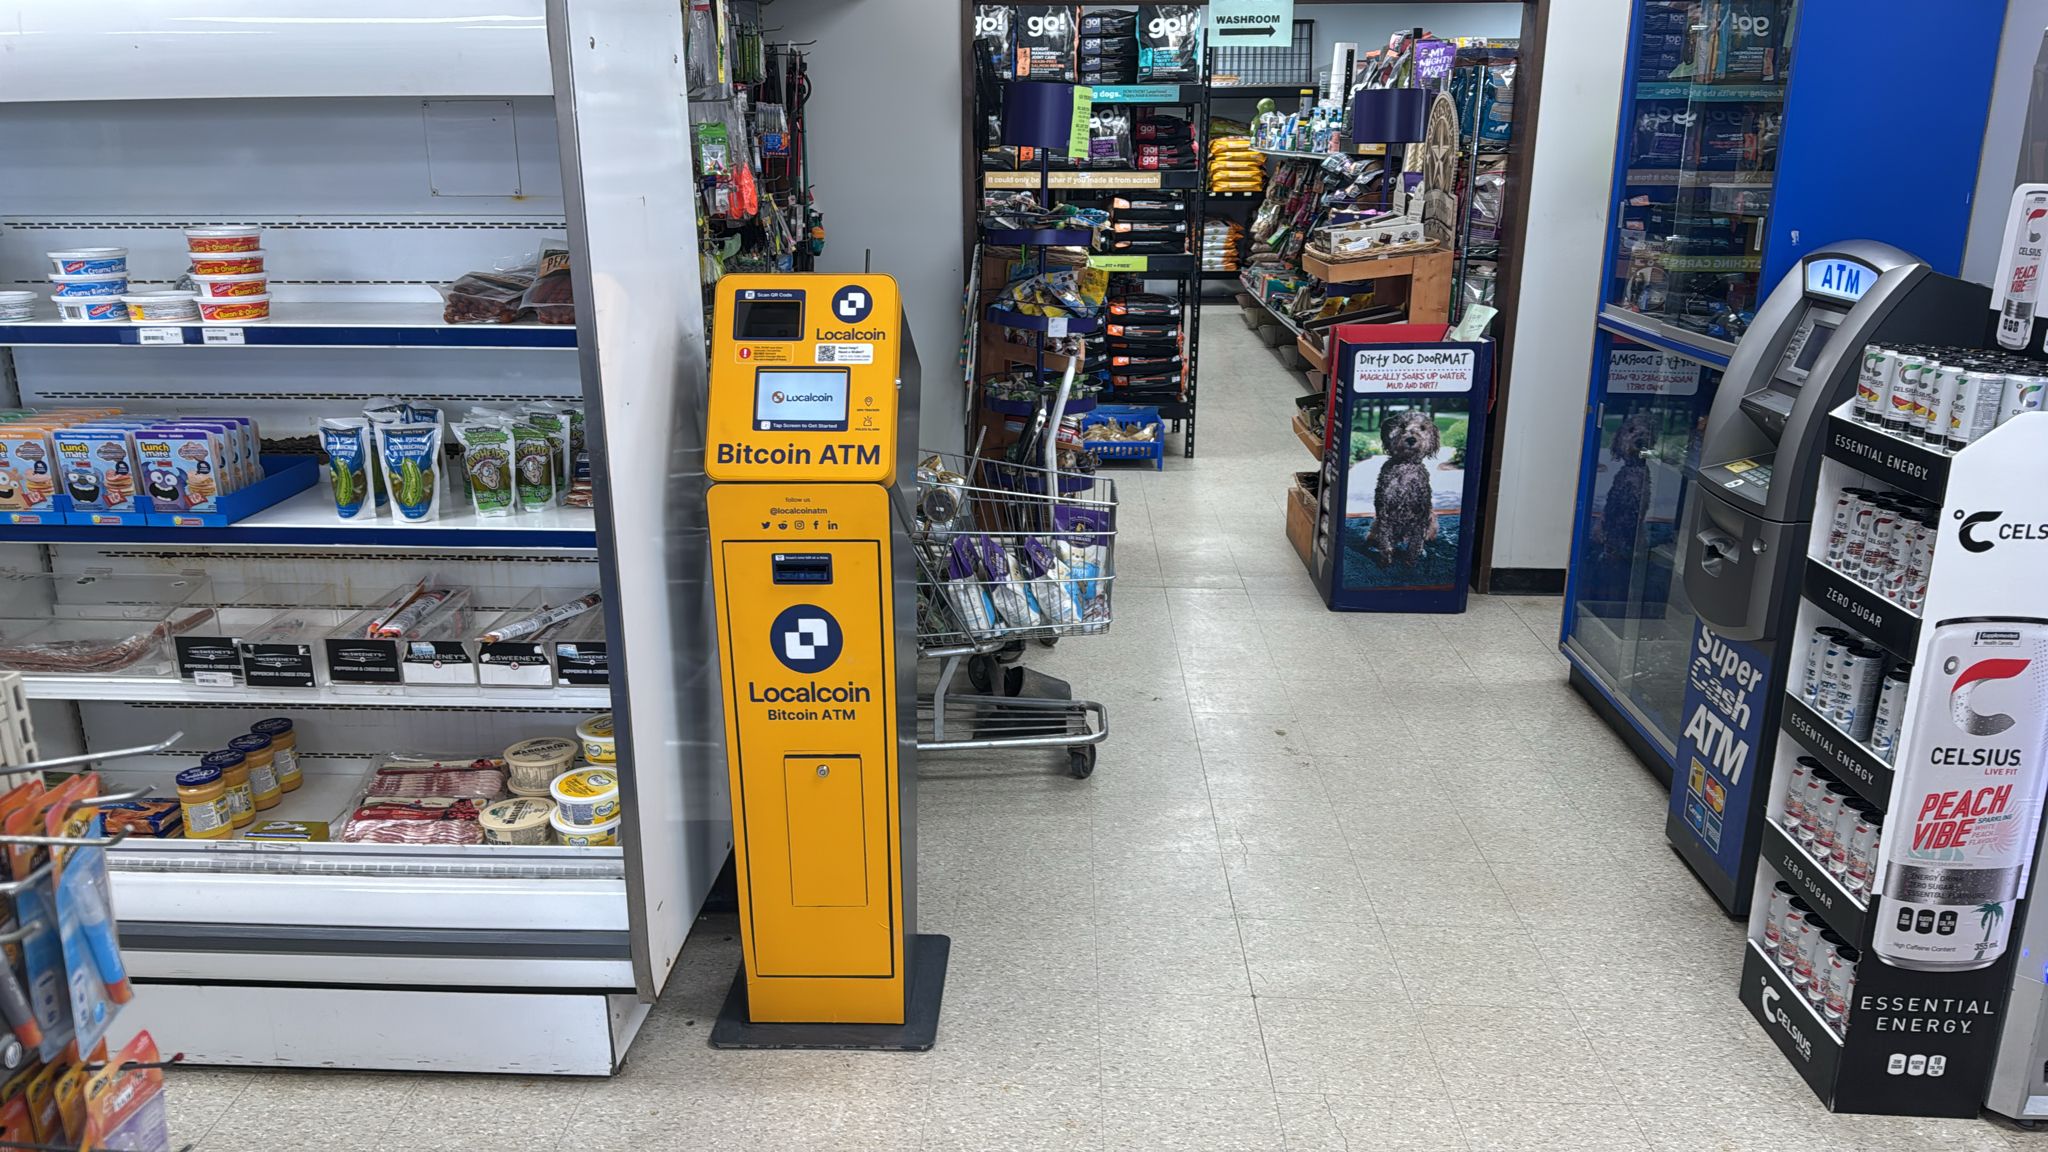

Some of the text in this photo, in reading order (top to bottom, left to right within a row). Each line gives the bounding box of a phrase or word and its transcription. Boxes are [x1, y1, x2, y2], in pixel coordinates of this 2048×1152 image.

[1085, 18, 1100, 28] go!
[1216, 14, 1280, 24] WASHROOM
[1027, 14, 1065, 37] go!
[1149, 15, 1186, 39] go!
[1085, 39, 1100, 50] go!
[1431, 47, 1445, 57] MY
[1419, 55, 1453, 67] MIGHTY
[1422, 63, 1449, 77] WOLF
[1099, 90, 1122, 99] dogs.
[1140, 124, 1155, 135] go!
[1142, 155, 1158, 165] go!
[1014, 177, 1030, 186] only
[2018, 247, 2042, 257] CELSIUS
[2013, 264, 2038, 280] PEACH
[1821, 264, 1860, 294] ATM
[2010, 279, 2027, 293] VIBE
[90, 303, 112, 316] Nalley
[816, 328, 886, 341] Localcoin
[1359, 353, 1390, 368] Dirty
[1426, 372, 1438, 380] UP
[786, 392, 833, 403] Localcoin
[60, 442, 89, 452] Lunch
[141, 442, 170, 452] Lunch
[64, 449, 88, 459] mate
[145, 449, 170, 459] mate
[467, 447, 508, 469] WARHEADS
[717, 443, 880, 465] Bitcoin ATM
[1834, 434, 1929, 481] ESSENTIAL ENERGY
[769, 507, 828, 516] @localcoinatm
[1999, 523, 2048, 540] CELS
[1826, 587, 1883, 628] ZERO SUGAR
[407, 653, 467, 661] McSWEENEY'S
[488, 654, 544, 662] cSWEENEY'S
[1698, 624, 1763, 693] Super
[749, 681, 871, 703] Localcoin
[1691, 656, 1751, 731] Cash
[767, 709, 856, 721] Bitcoin ATM
[511, 742, 571, 756] MARGARINE
[1683, 703, 1750, 786] ATM
[1791, 713, 1874, 785] ESSENTIAL ENERGY
[1931, 747, 2022, 766] CELSIUS
[2004, 768, 2018, 776] FIT
[1917, 784, 2013, 822] PEACH
[1977, 814, 2013, 824] SPARKLING
[1912, 818, 1977, 851] VIBE
[1967, 837, 1998, 846] FLAVOUR
[1782, 854, 1833, 910] ZERO SUGAR
[1910, 872, 1939, 882] ENERGY
[1905, 943, 1930, 952] Caffeine
[1974, 942, 1988, 951] 355
[1860, 996, 1995, 1015] ESSENTIAL
[1875, 1016, 1972, 1034] ENERGY
[1776, 1007, 1812, 1056] CELSIUS
[1934, 1057, 1942, 1066] 10
